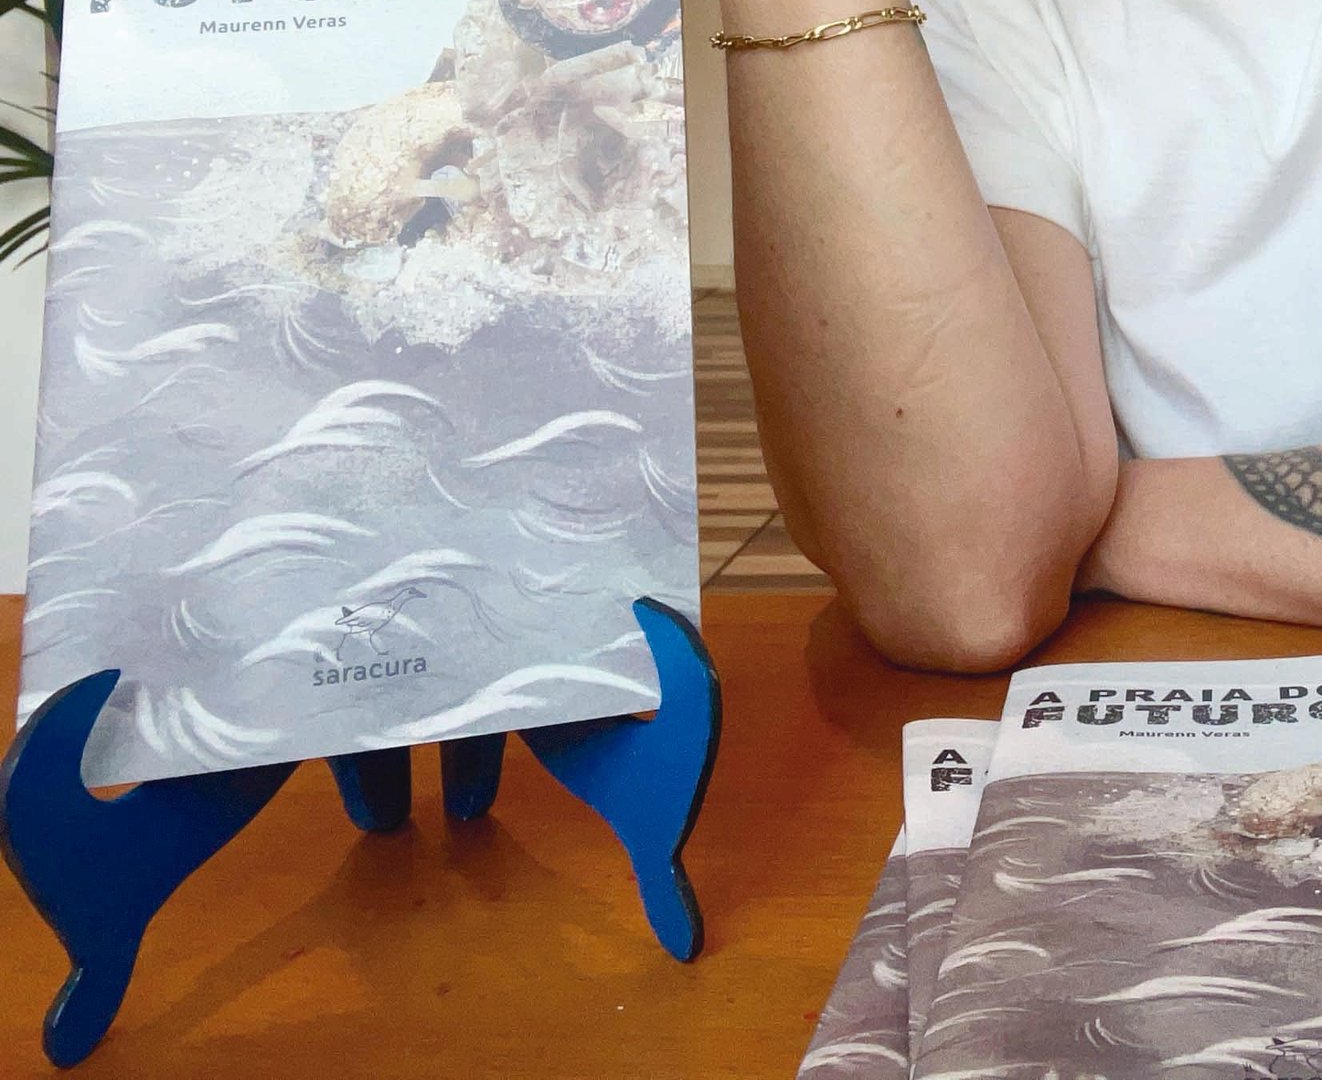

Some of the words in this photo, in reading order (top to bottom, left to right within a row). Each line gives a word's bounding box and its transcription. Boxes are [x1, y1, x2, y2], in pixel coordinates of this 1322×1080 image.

[199, 17, 287, 35] Maurenn
[292, 14, 347, 31] Veras
[312, 656, 428, 687] saracura
[1029, 691, 1063, 707] A
[1089, 688, 1253, 703] PRAIA
[1119, 730, 1197, 739] Maurenn
[1201, 730, 1251, 739] Veras
[932, 749, 968, 765] A
